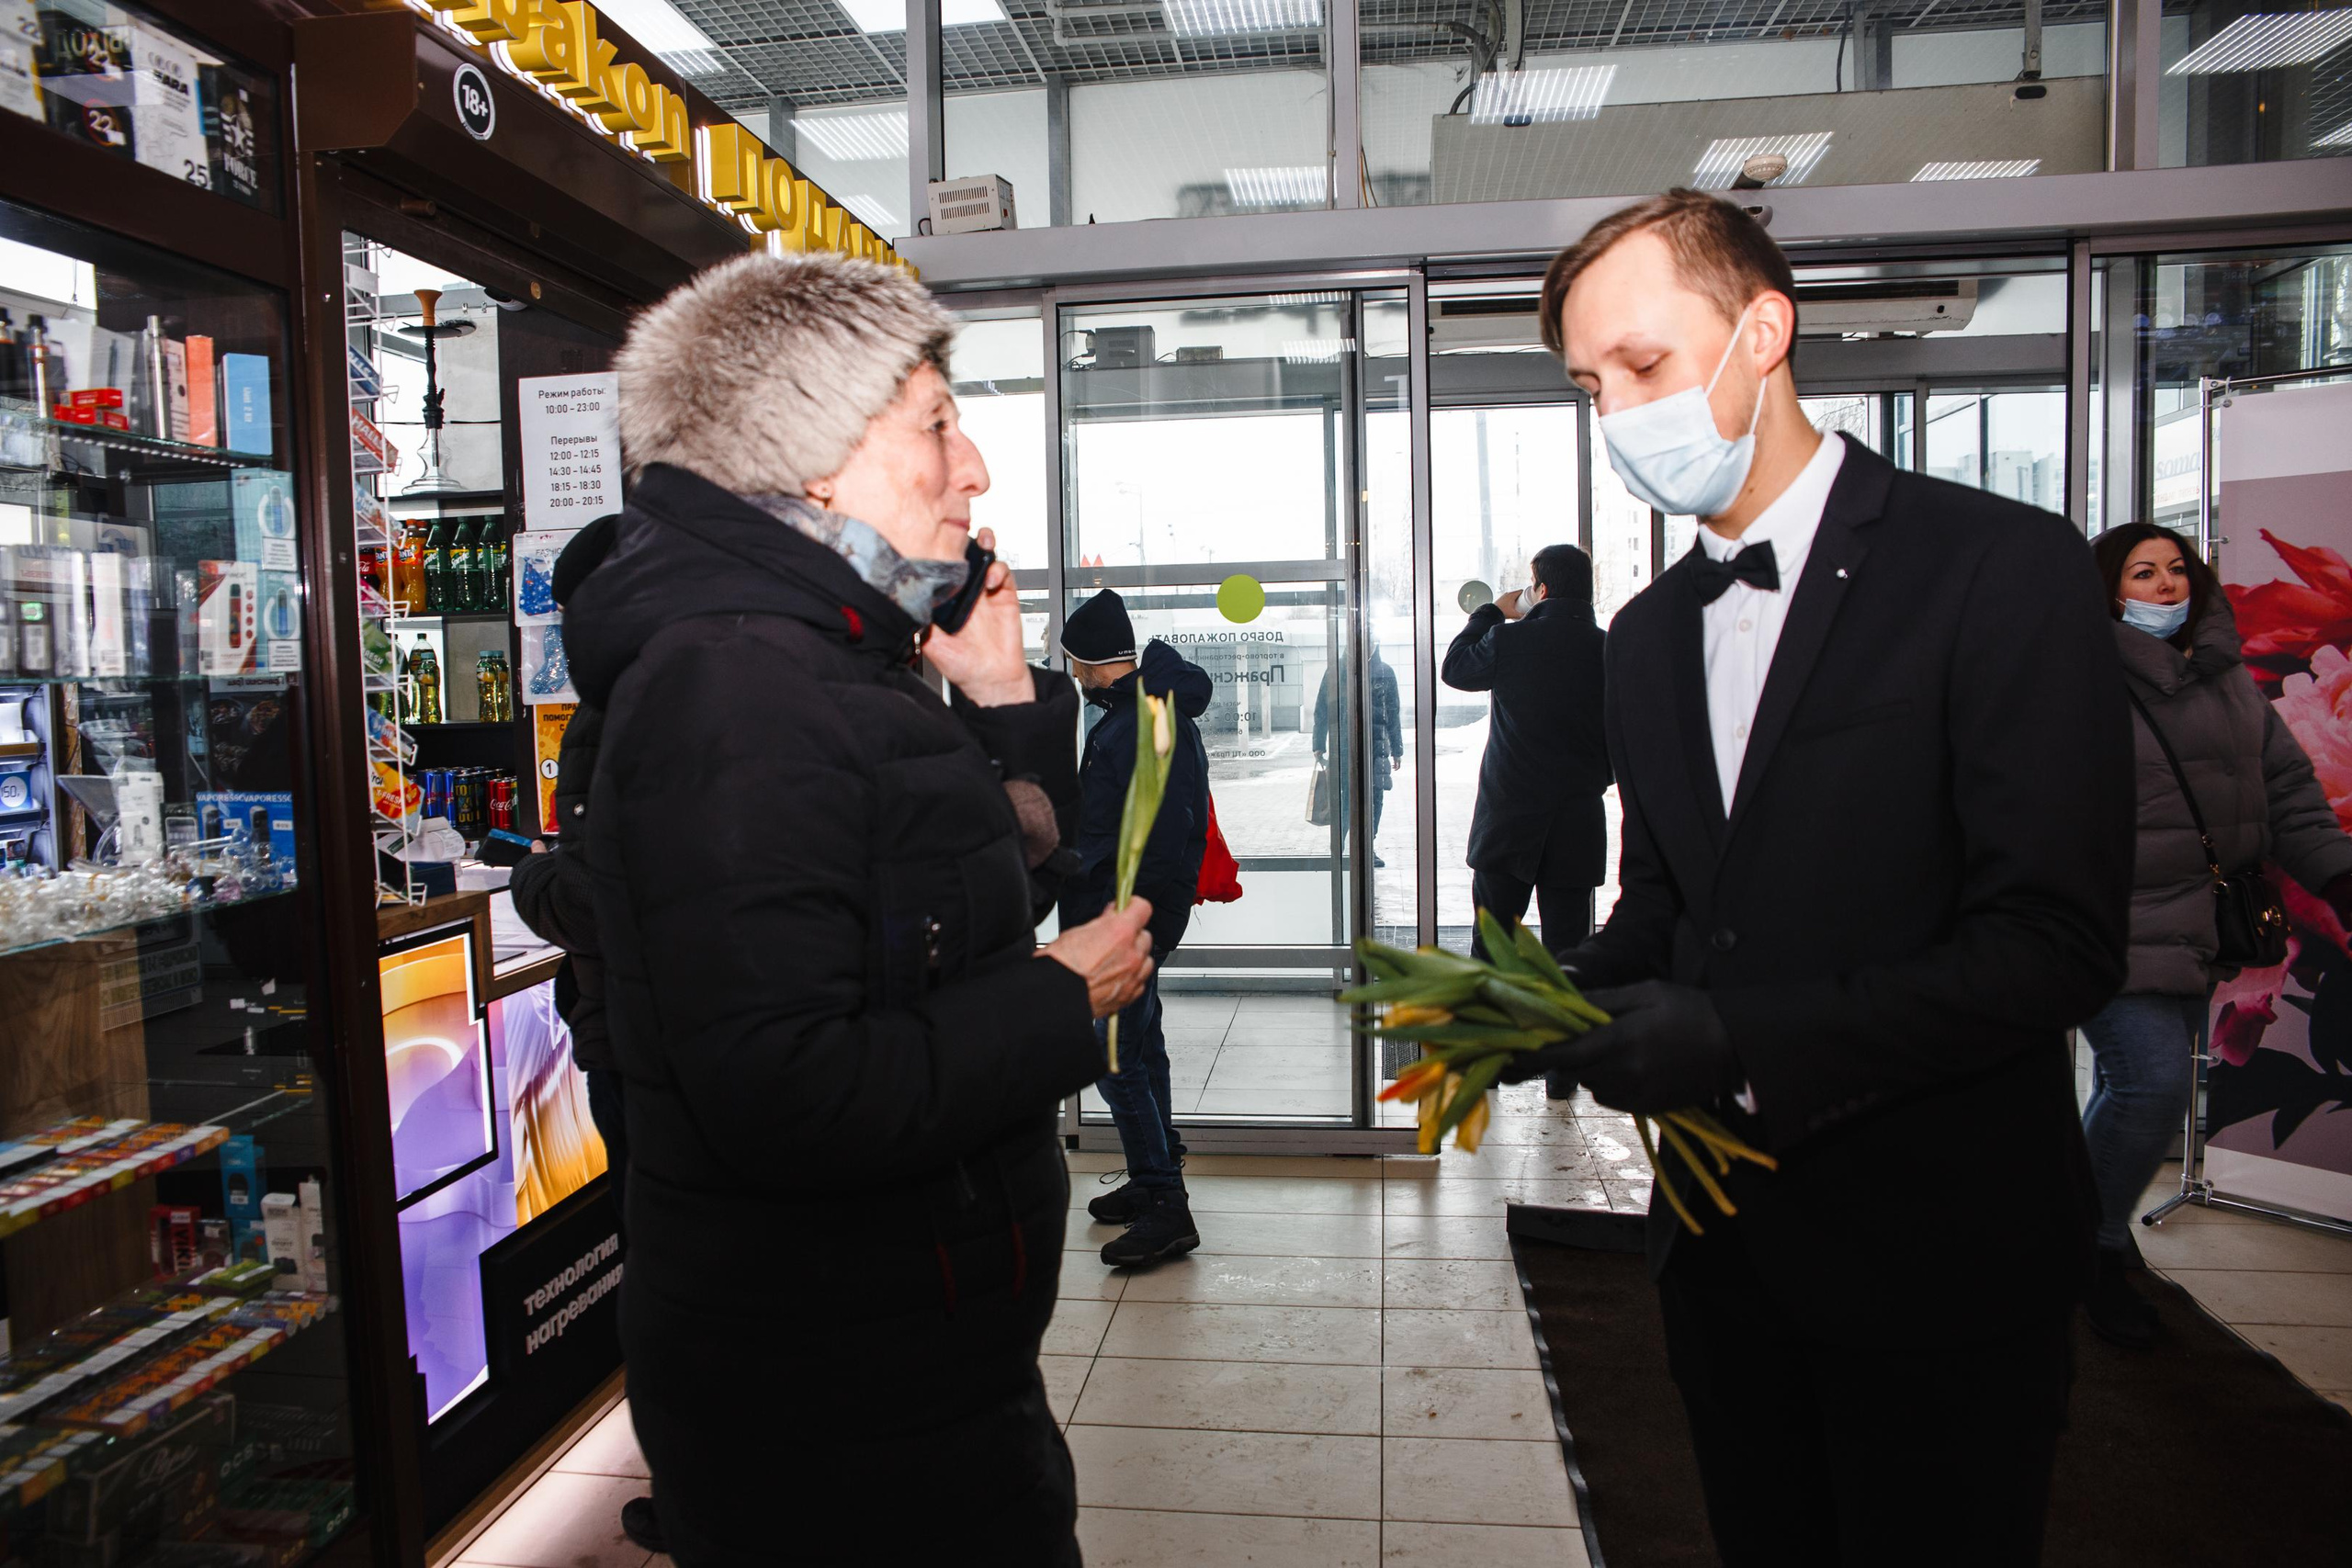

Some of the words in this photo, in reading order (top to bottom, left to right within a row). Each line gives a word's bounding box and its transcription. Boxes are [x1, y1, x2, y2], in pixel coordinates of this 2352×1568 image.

[461, 84, 489, 117] 18+
[184, 158, 209, 189] 25
[538, 389, 569, 399] Режим
[571, 387, 606, 399] работы:
[546, 404, 568, 414] 10:00
[577, 401, 600, 412] 23:00
[550, 434, 598, 446] Перерывы
[550, 450, 571, 460] 12:00
[580, 448, 599, 458] 12:15
[548, 466, 571, 476] 14:30
[580, 464, 602, 474] 14:45
[551, 481, 571, 491] 18:15
[579, 479, 601, 490] 18:30
[549, 497, 573, 507] 20:00
[582, 495, 604, 505] 20:15
[364, 649, 384, 665] RESH
[546, 761, 552, 774] 1
[524, 1233, 618, 1315] технология
[526, 1262, 624, 1355] нагревания
